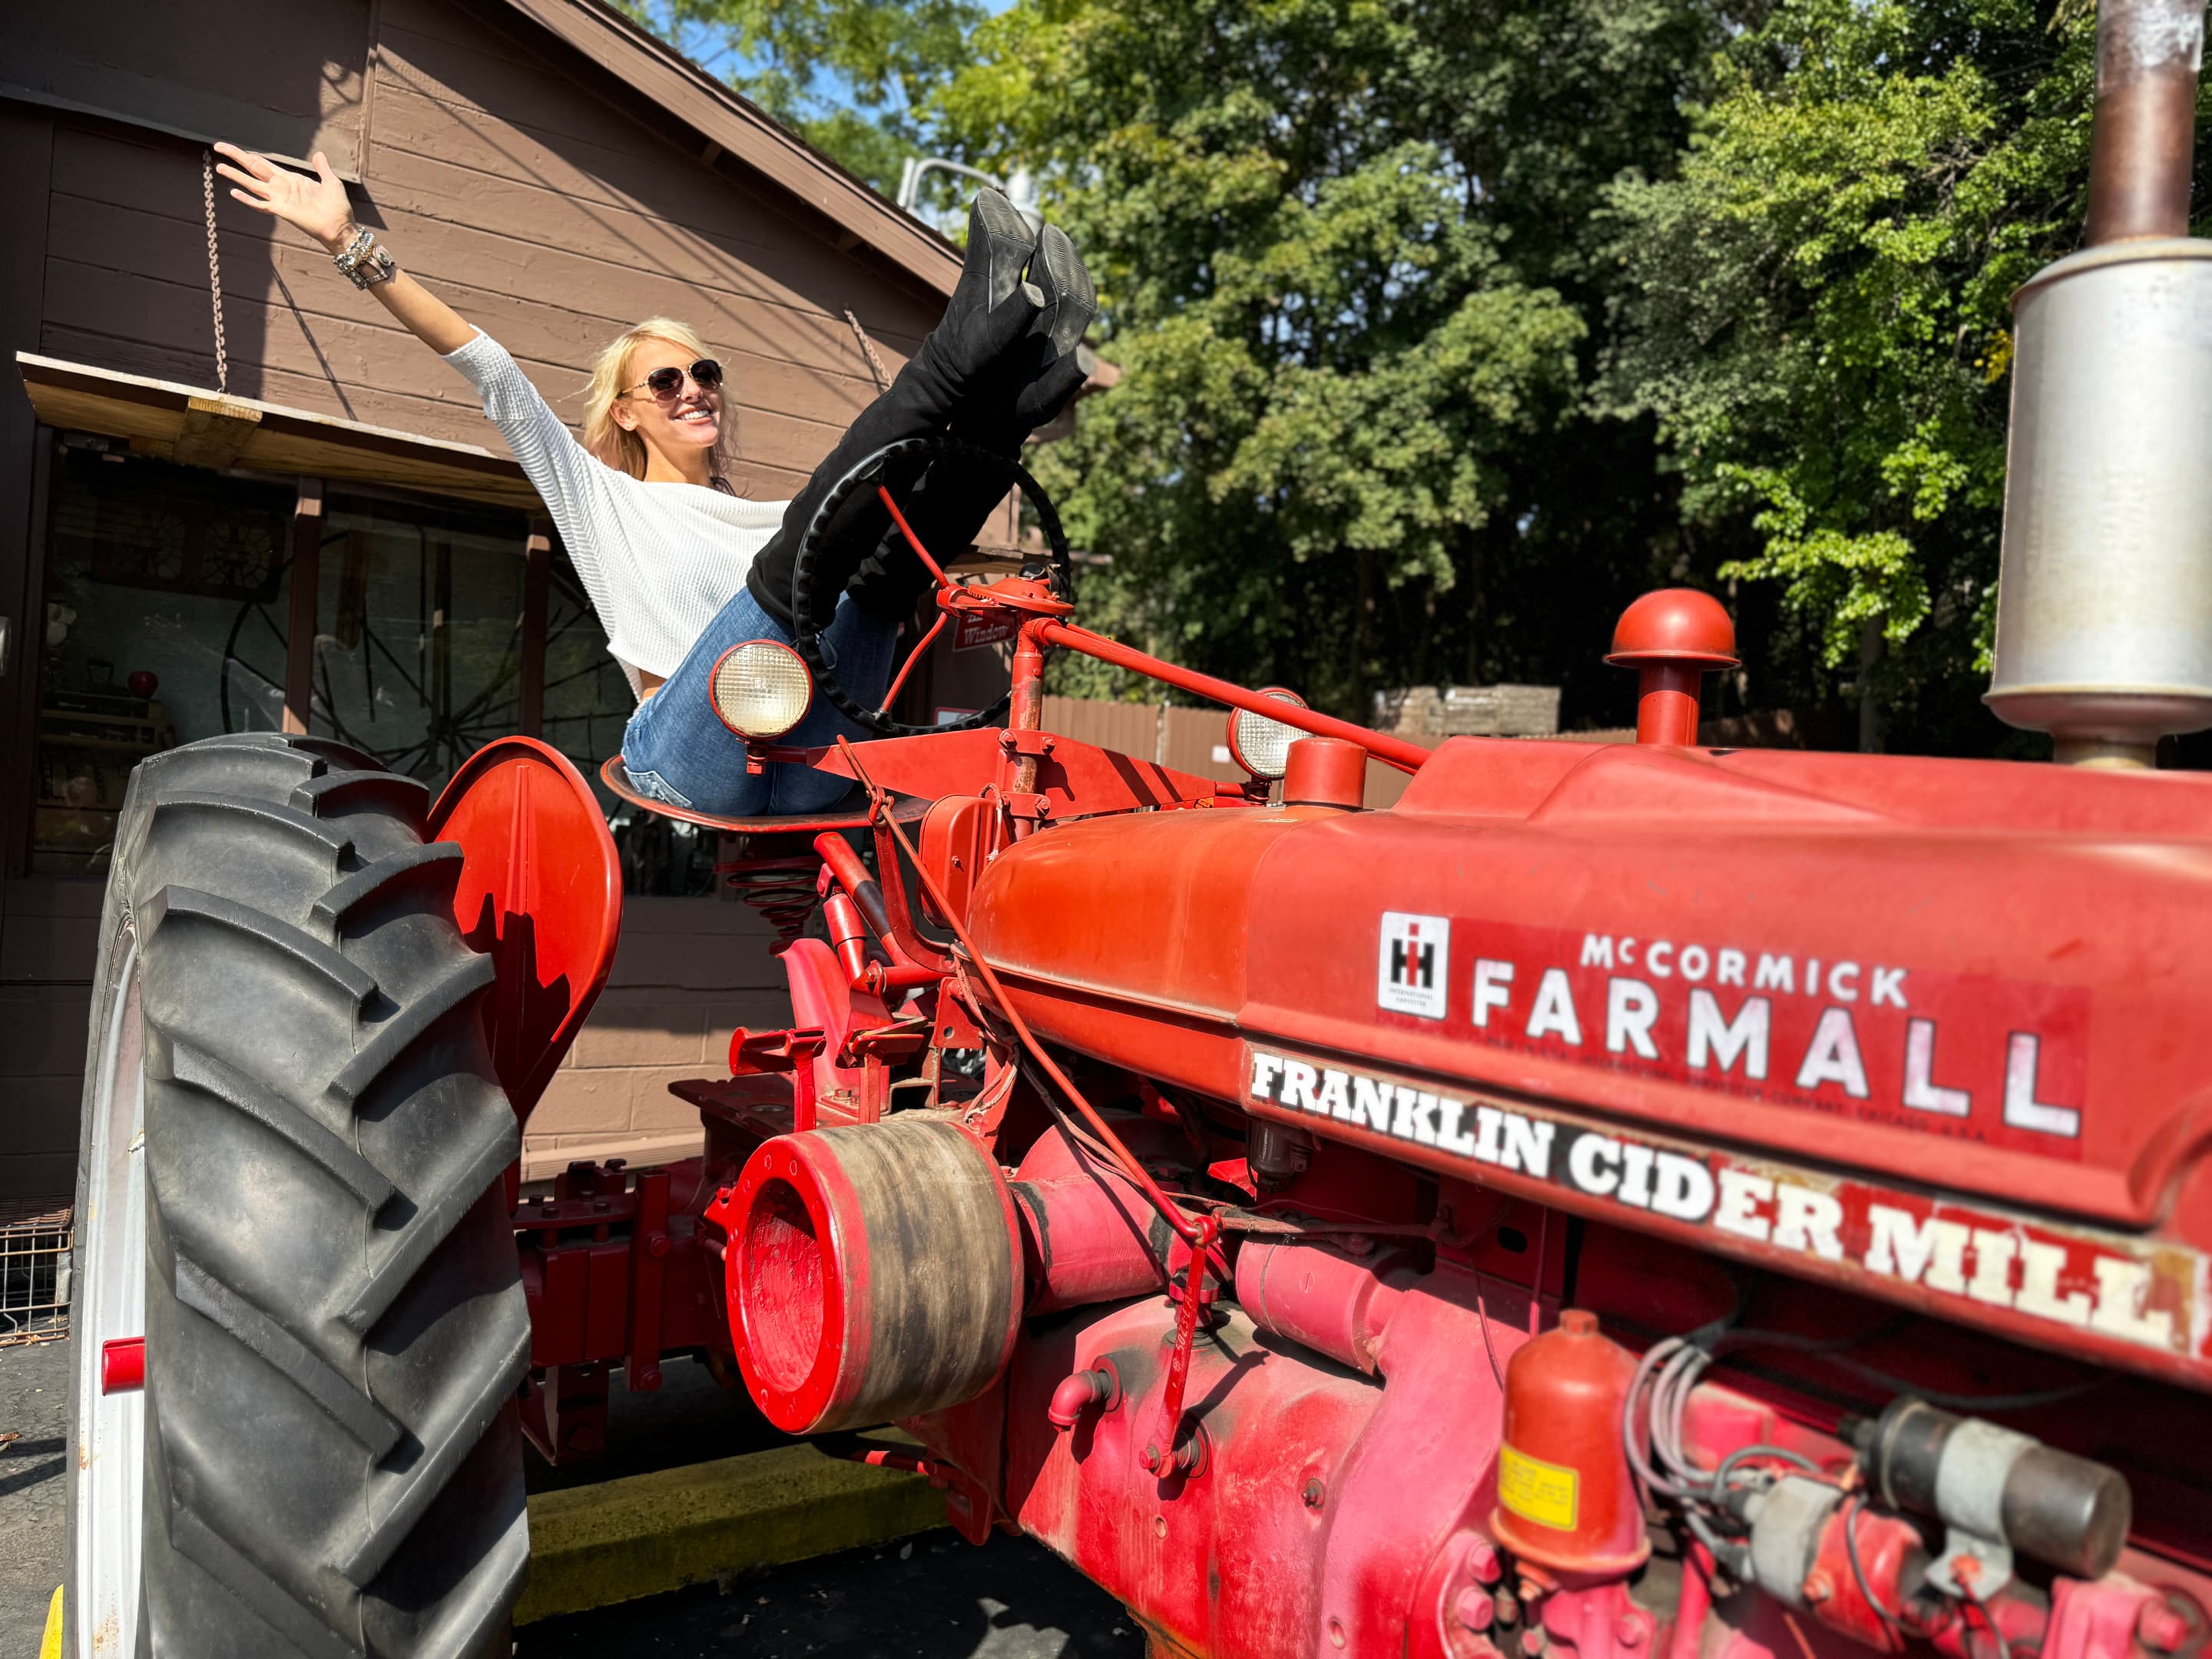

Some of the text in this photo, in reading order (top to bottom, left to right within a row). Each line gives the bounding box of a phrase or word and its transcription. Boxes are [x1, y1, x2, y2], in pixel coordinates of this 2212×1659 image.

[965, 624, 1008, 644] Window
[1389, 988, 1432, 1000] INTERNATIONAL
[1396, 998, 1426, 1007] HARVESTER
[1472, 958, 2081, 1138] FARMALL
[1251, 1051, 2173, 1347] FRANKLIN CIDER MILL
